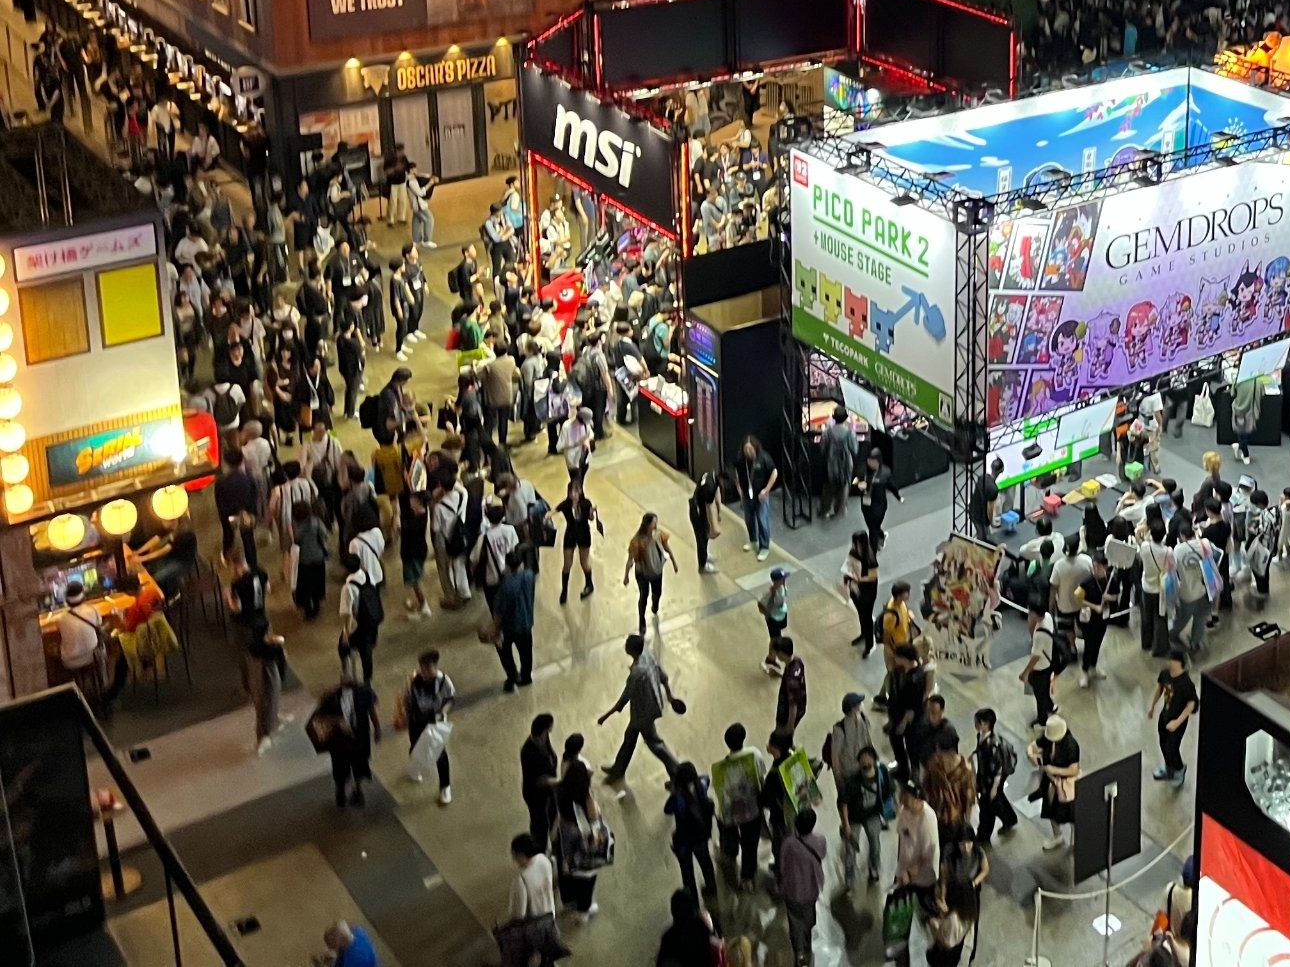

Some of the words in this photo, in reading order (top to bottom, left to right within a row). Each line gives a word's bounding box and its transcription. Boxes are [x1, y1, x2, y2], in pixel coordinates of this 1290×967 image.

[397, 59, 455, 91] OSCAR'S
[456, 54, 496, 82] PIZZA
[553, 103, 635, 188] msi
[813, 183, 854, 229] PICO
[861, 207, 912, 259] PARK
[917, 235, 929, 268] 2
[1105, 192, 1284, 270] GEMDROPS
[857, 251, 892, 286] STAGE
[1119, 259, 1175, 287] GAME
[1189, 232, 1272, 266] STUDIOS
[831, 336, 869, 369] TECOPARK
